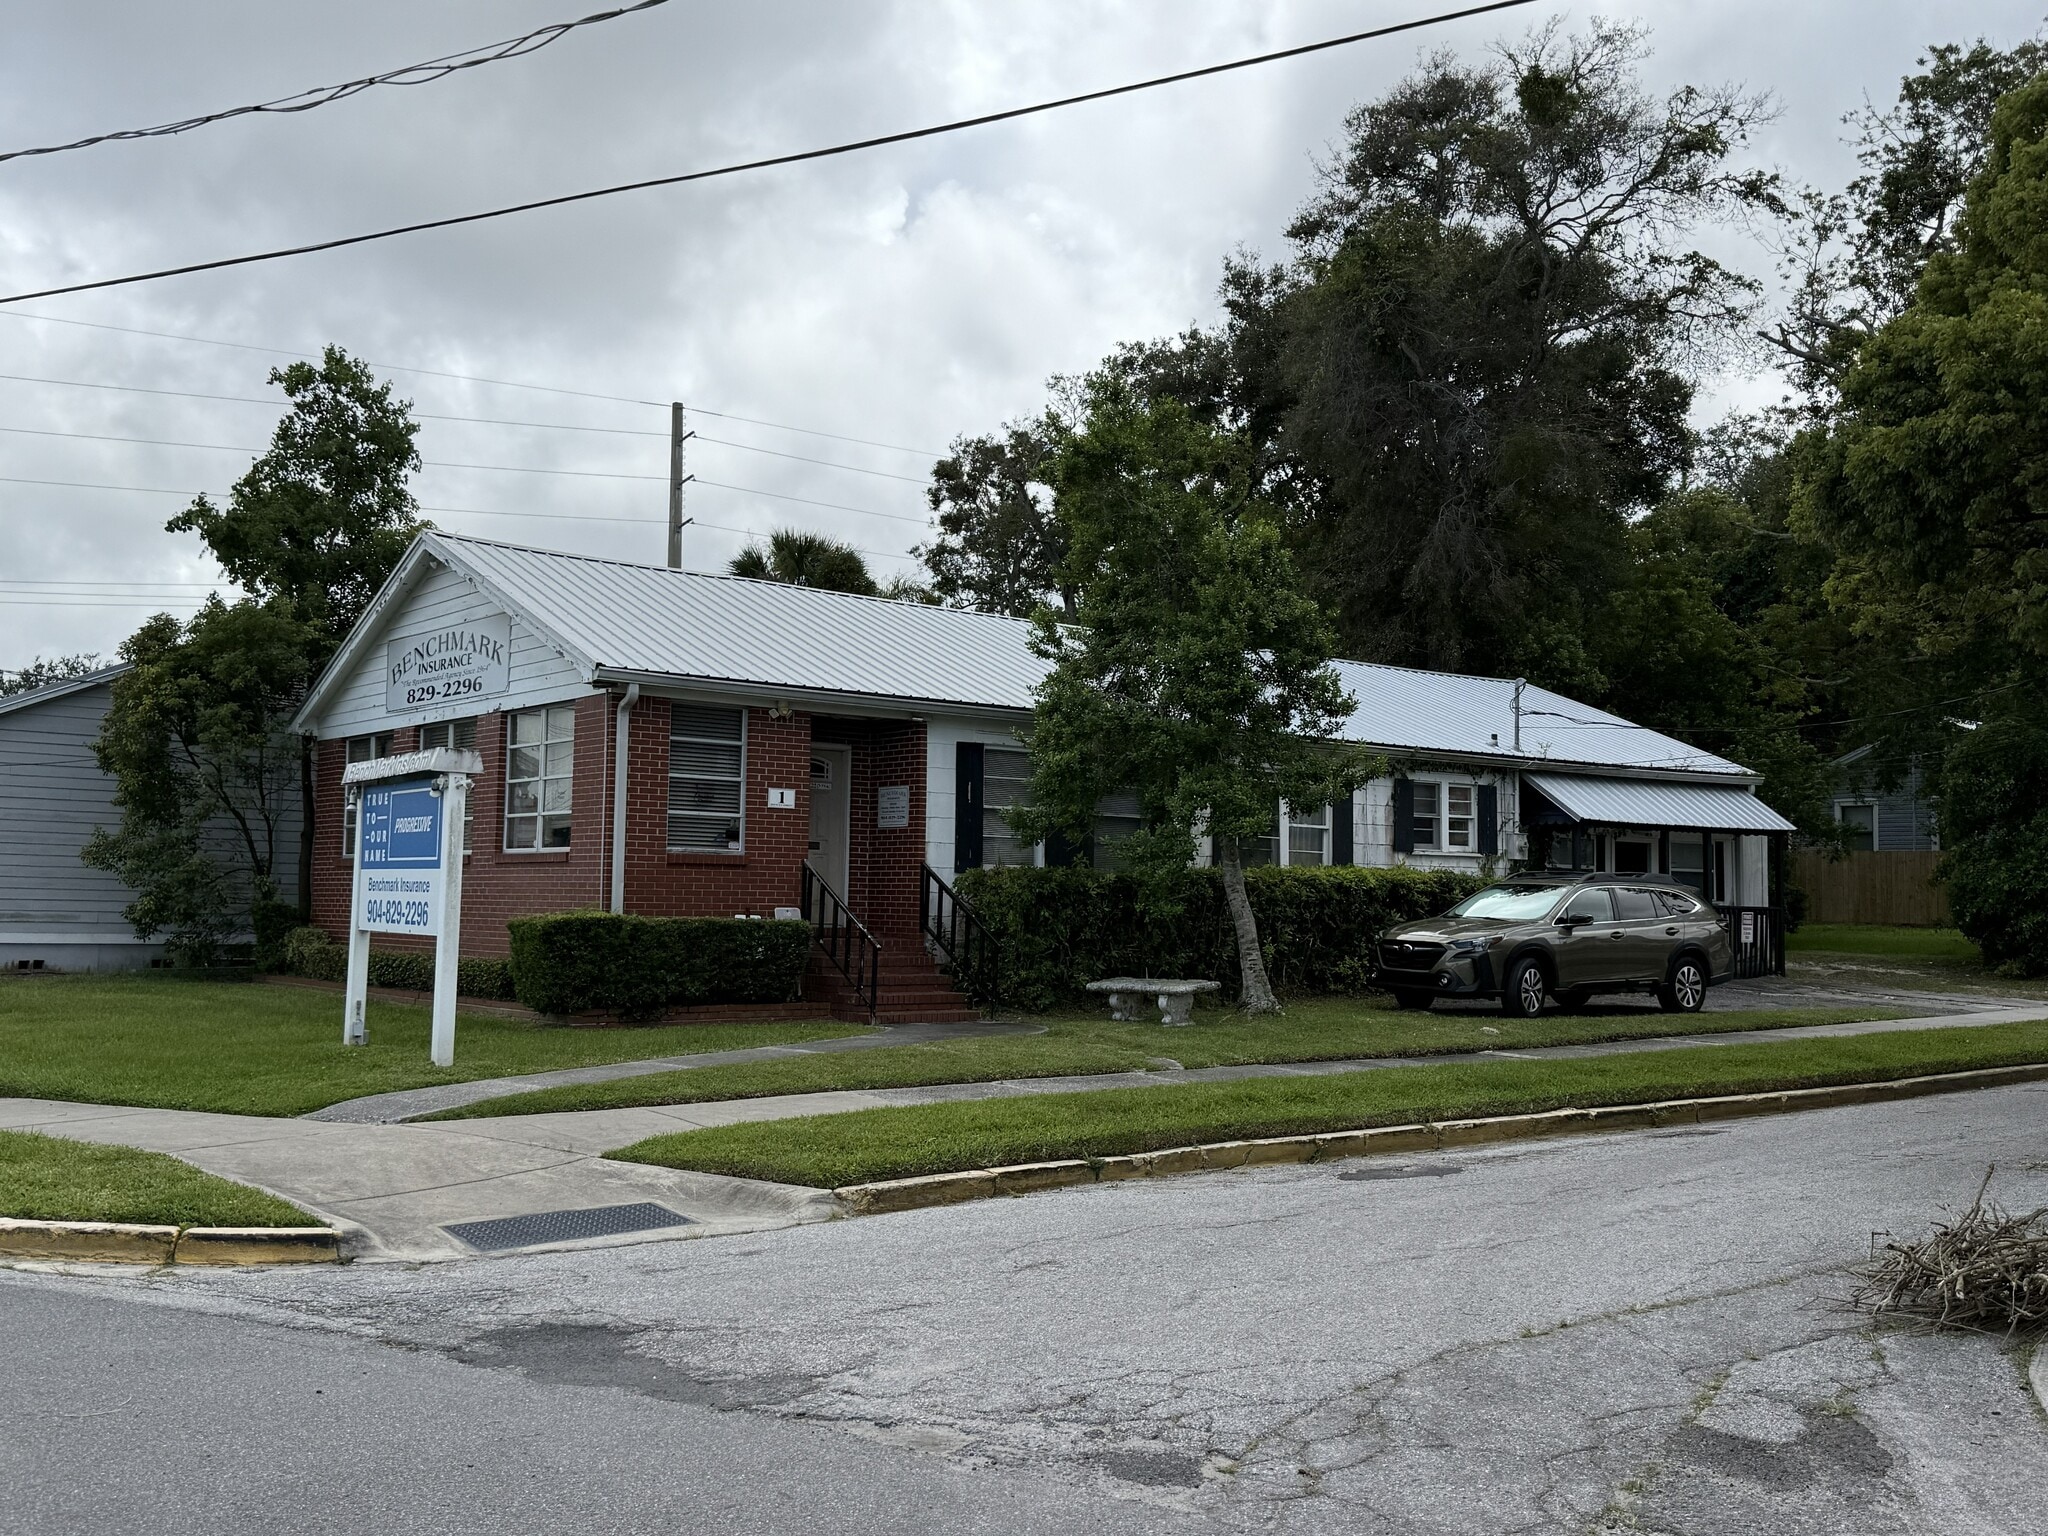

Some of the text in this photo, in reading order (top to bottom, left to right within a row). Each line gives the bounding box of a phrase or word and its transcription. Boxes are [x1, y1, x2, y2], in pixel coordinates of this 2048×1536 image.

[392, 631, 504, 686] BENCHMARK
[418, 653, 473, 676] INSURANCE
[406, 676, 483, 704] 829-2296
[367, 792, 389, 807] TRUE
[779, 791, 785, 804] 1
[393, 815, 434, 834] PROGRESSIVE
[364, 849, 386, 862] NAME
[368, 877, 430, 893] Benchmark Insurance
[367, 899, 429, 927] 904-829-2296
